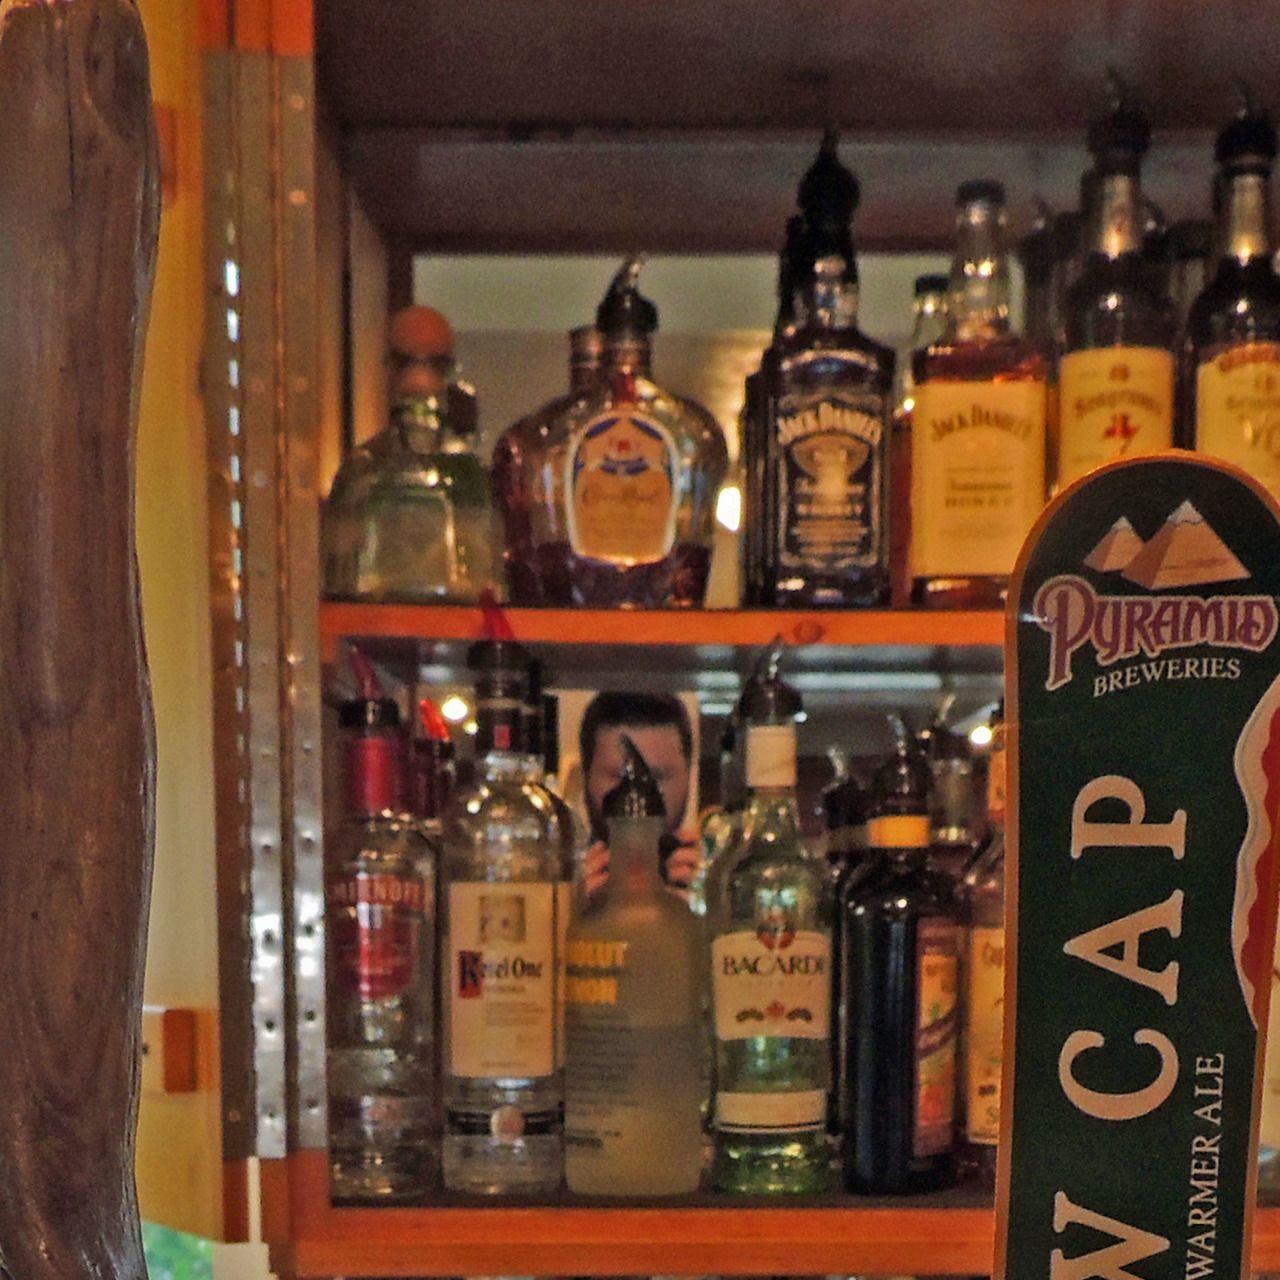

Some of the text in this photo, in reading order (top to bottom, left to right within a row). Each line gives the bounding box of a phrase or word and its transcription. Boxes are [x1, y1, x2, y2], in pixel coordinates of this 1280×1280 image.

[1033, 574, 1280, 692] PYRAMID
[1093, 658, 1242, 699] BREWERIES
[1057, 773, 1188, 1122] CAP
[1194, 1052, 1225, 1126] ALE
